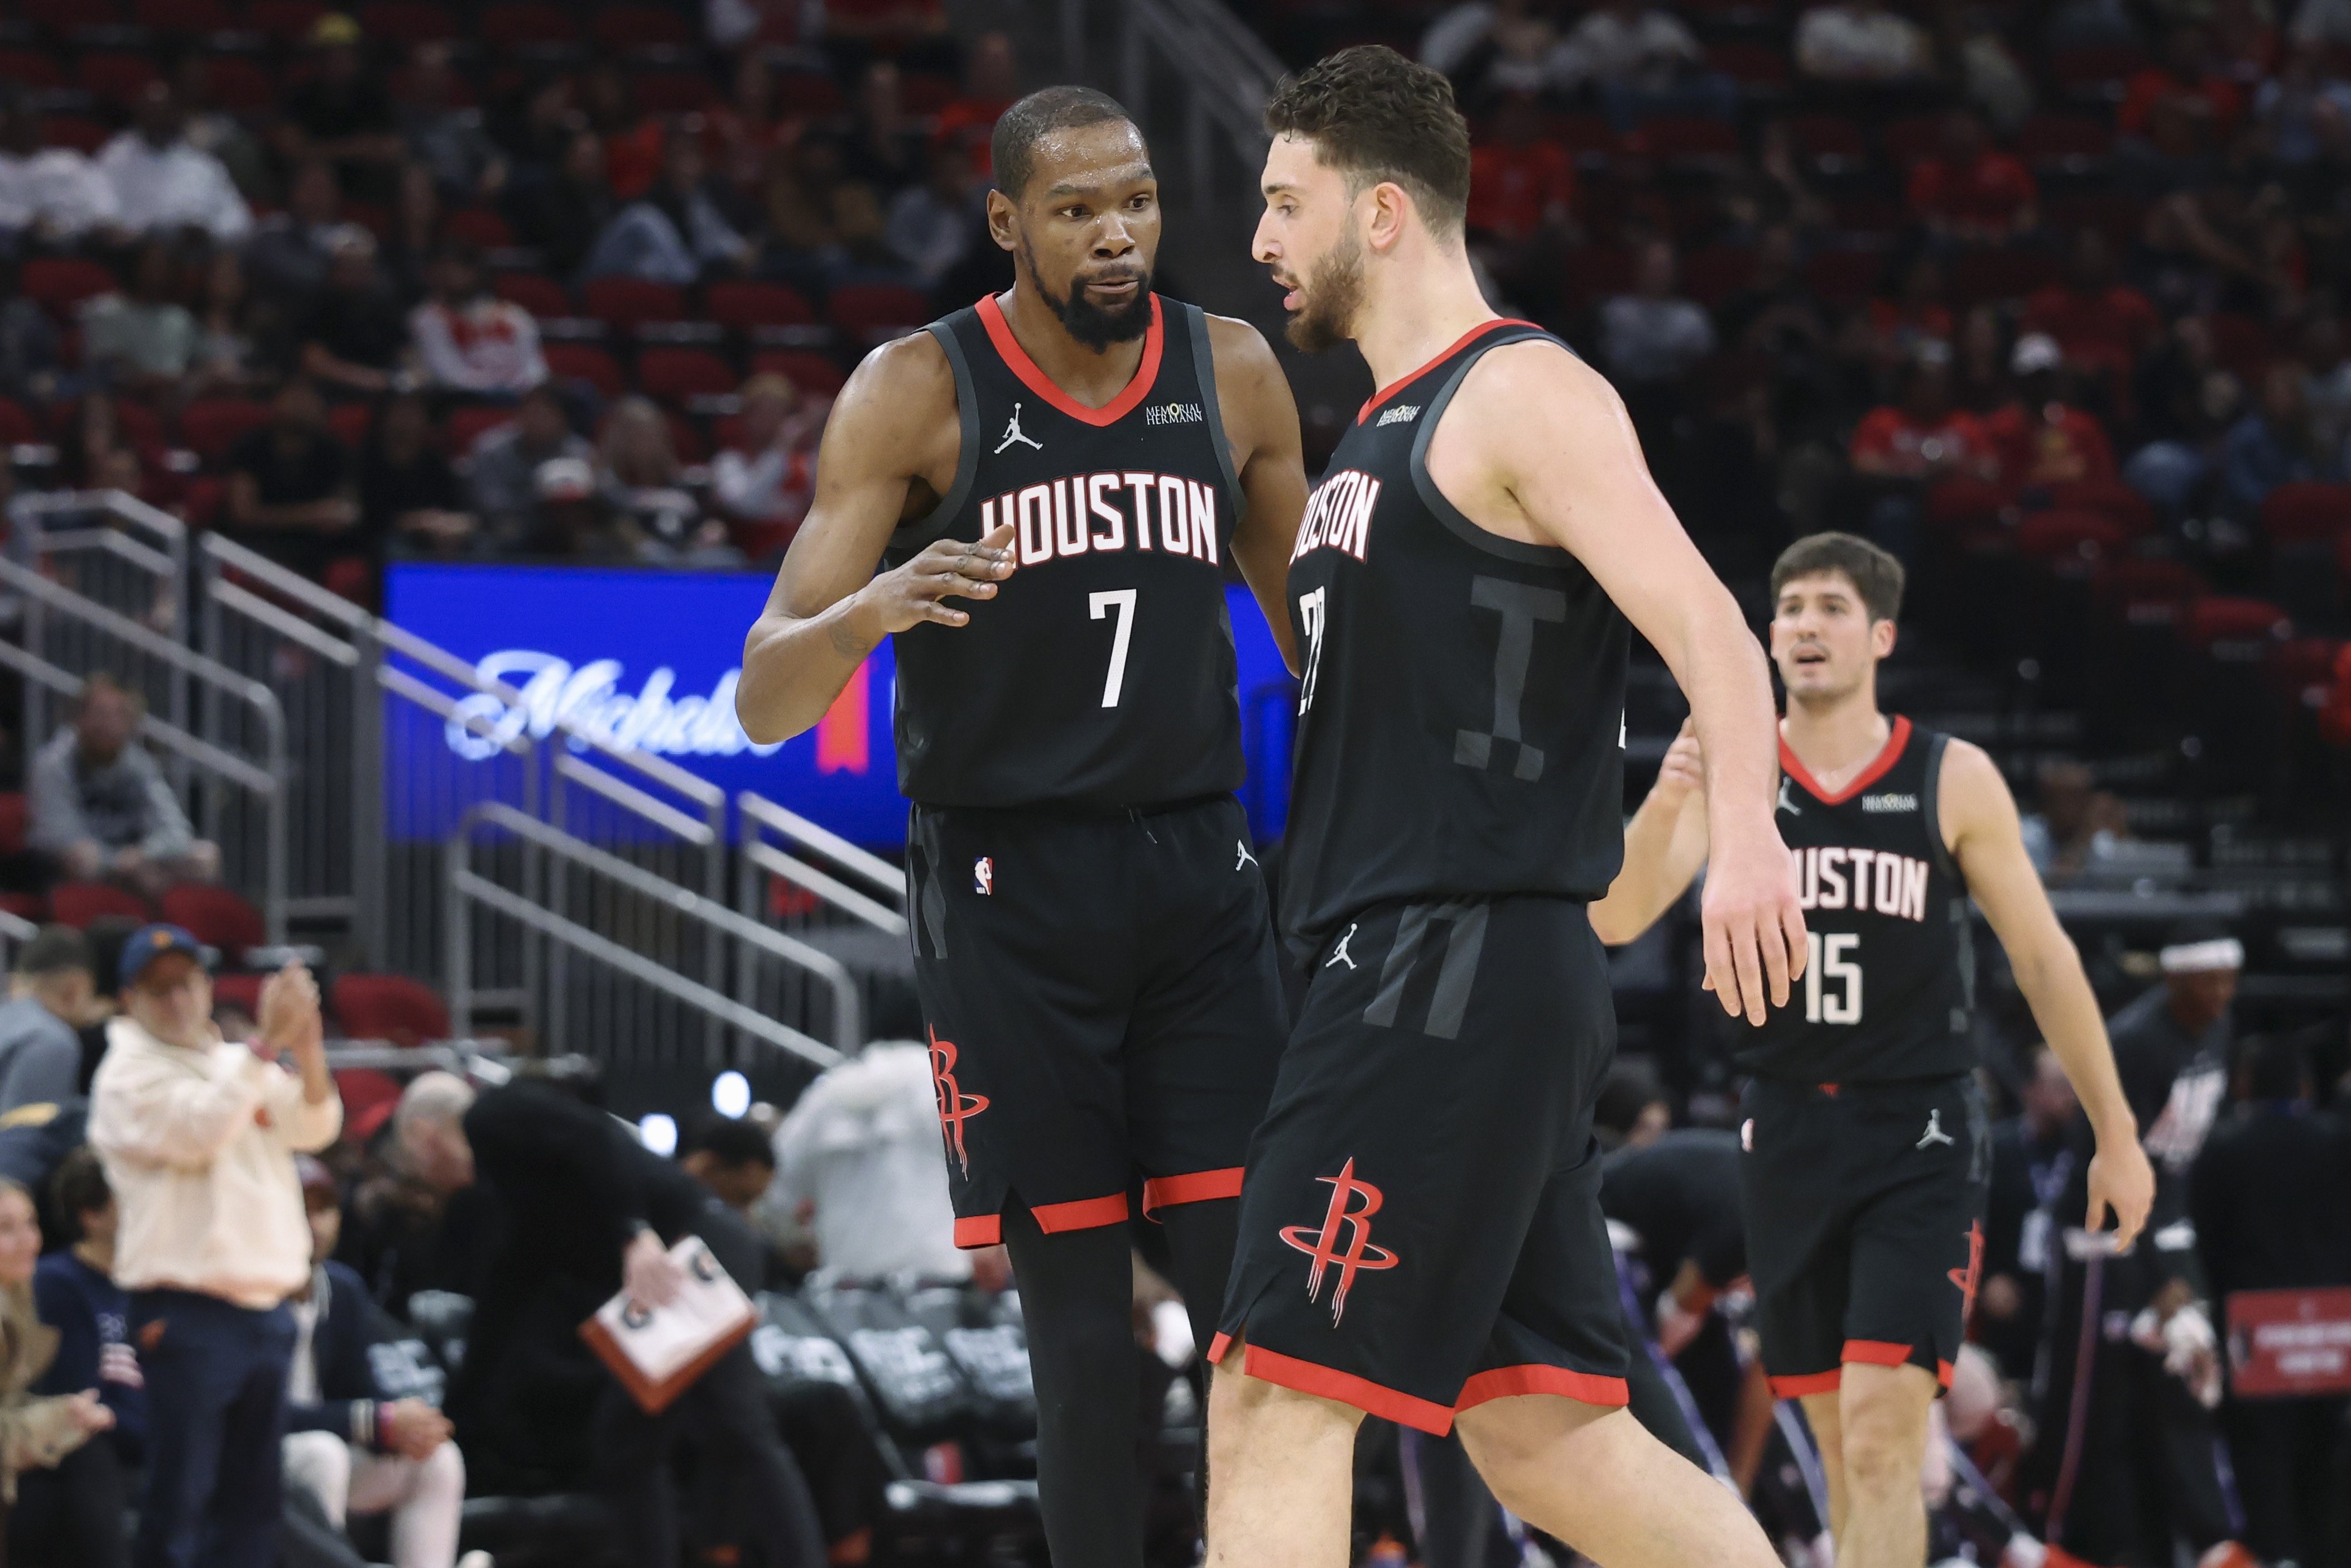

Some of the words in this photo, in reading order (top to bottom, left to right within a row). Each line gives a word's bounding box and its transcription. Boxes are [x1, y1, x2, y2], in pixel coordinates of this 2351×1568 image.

[1146, 403, 1201, 416] MEMORIAL
[1147, 412, 1203, 425] HERMANN
[1289, 468, 1382, 567] OUSTON
[1089, 589, 1137, 708] 7
[1792, 846, 1929, 922] USTON
[1805, 931, 1864, 1025] 15
